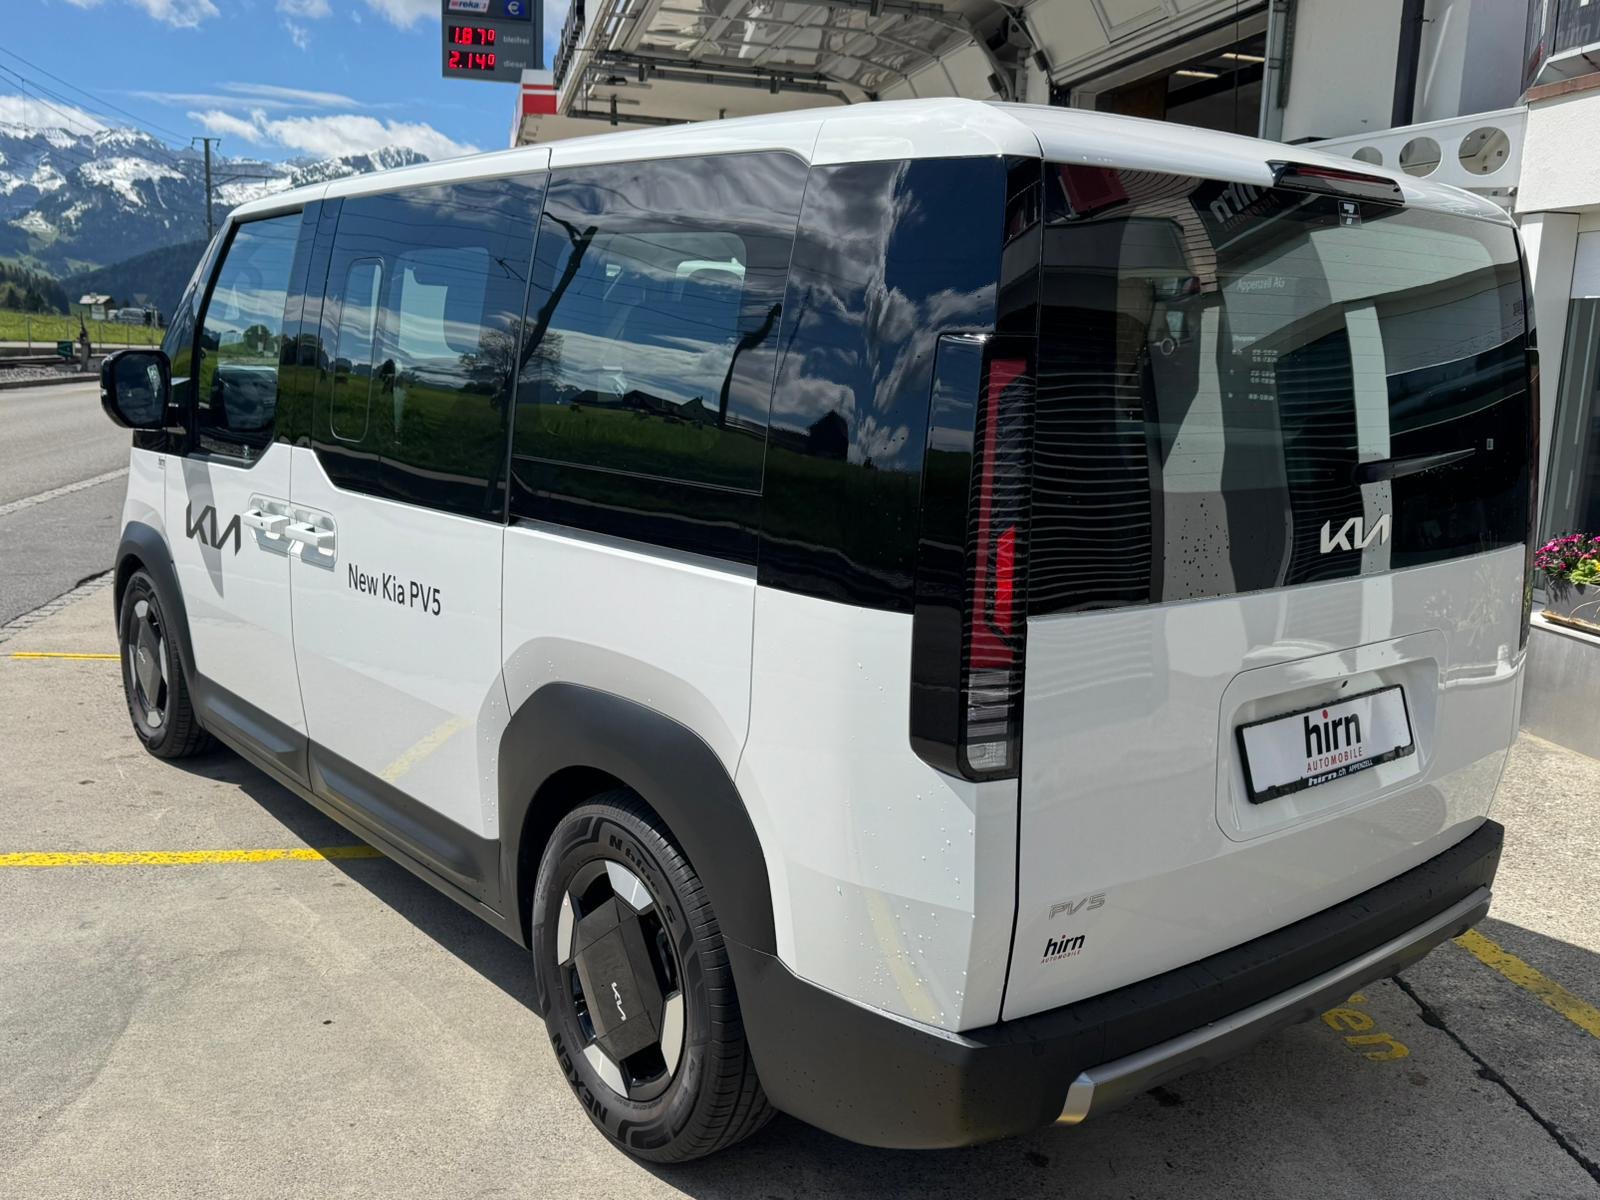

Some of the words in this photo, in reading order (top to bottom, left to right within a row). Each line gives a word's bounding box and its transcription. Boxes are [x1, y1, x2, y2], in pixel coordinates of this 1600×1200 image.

[186, 501, 241, 557] KIA
[1320, 514, 1390, 554] KIA
[348, 563, 379, 597] New
[382, 572, 405, 605] Kia
[410, 581, 441, 616] PV5
[1304, 709, 1362, 759] hirn
[1306, 746, 1363, 774] AUTOMOBILE
[1048, 892, 1106, 920] PV5
[1043, 934, 1086, 958] hirn
[552, 1032, 609, 1125] NEXEN
